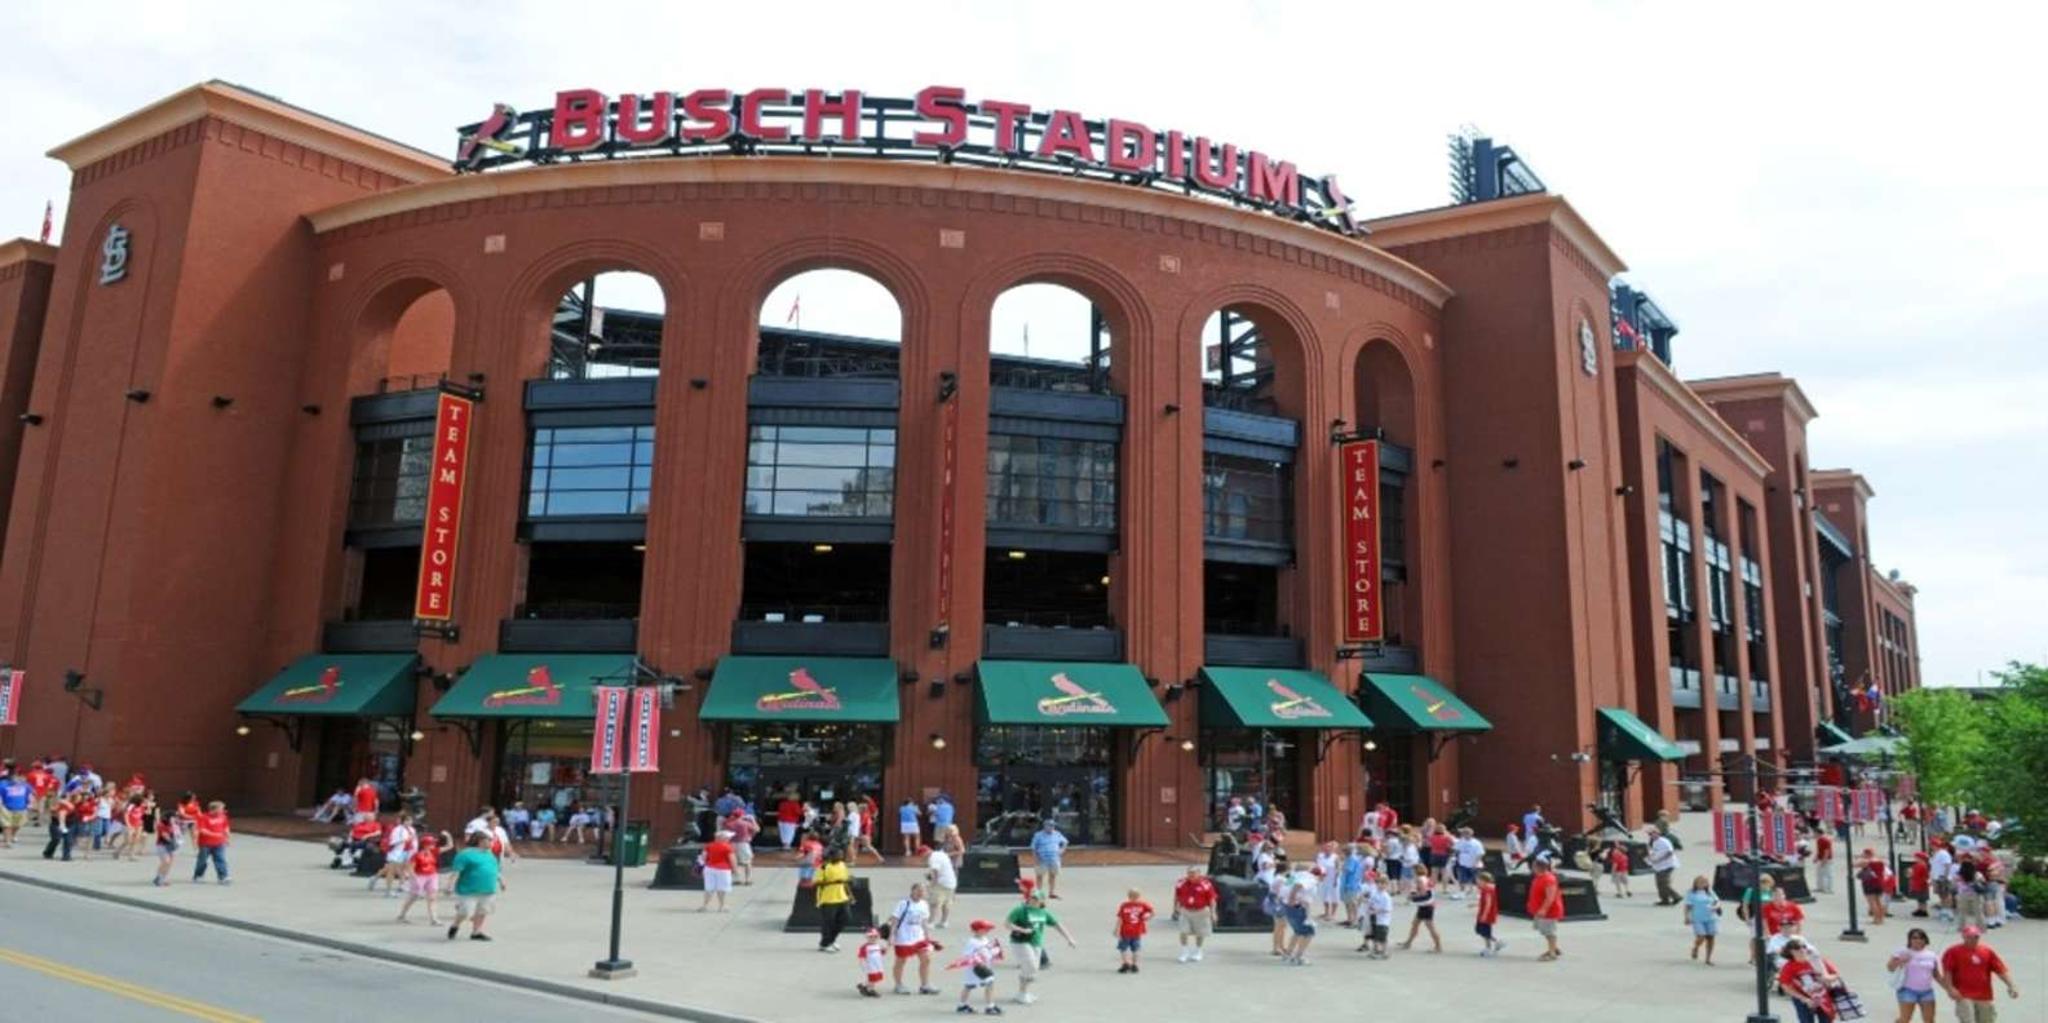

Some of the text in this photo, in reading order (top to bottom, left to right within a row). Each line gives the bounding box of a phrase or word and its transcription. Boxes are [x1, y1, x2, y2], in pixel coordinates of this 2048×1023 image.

[548, 84, 1300, 206] BUSCH STADIUM
[429, 404, 463, 610] TEAM STORE
[1352, 449, 1371, 632] TEAM STORE
